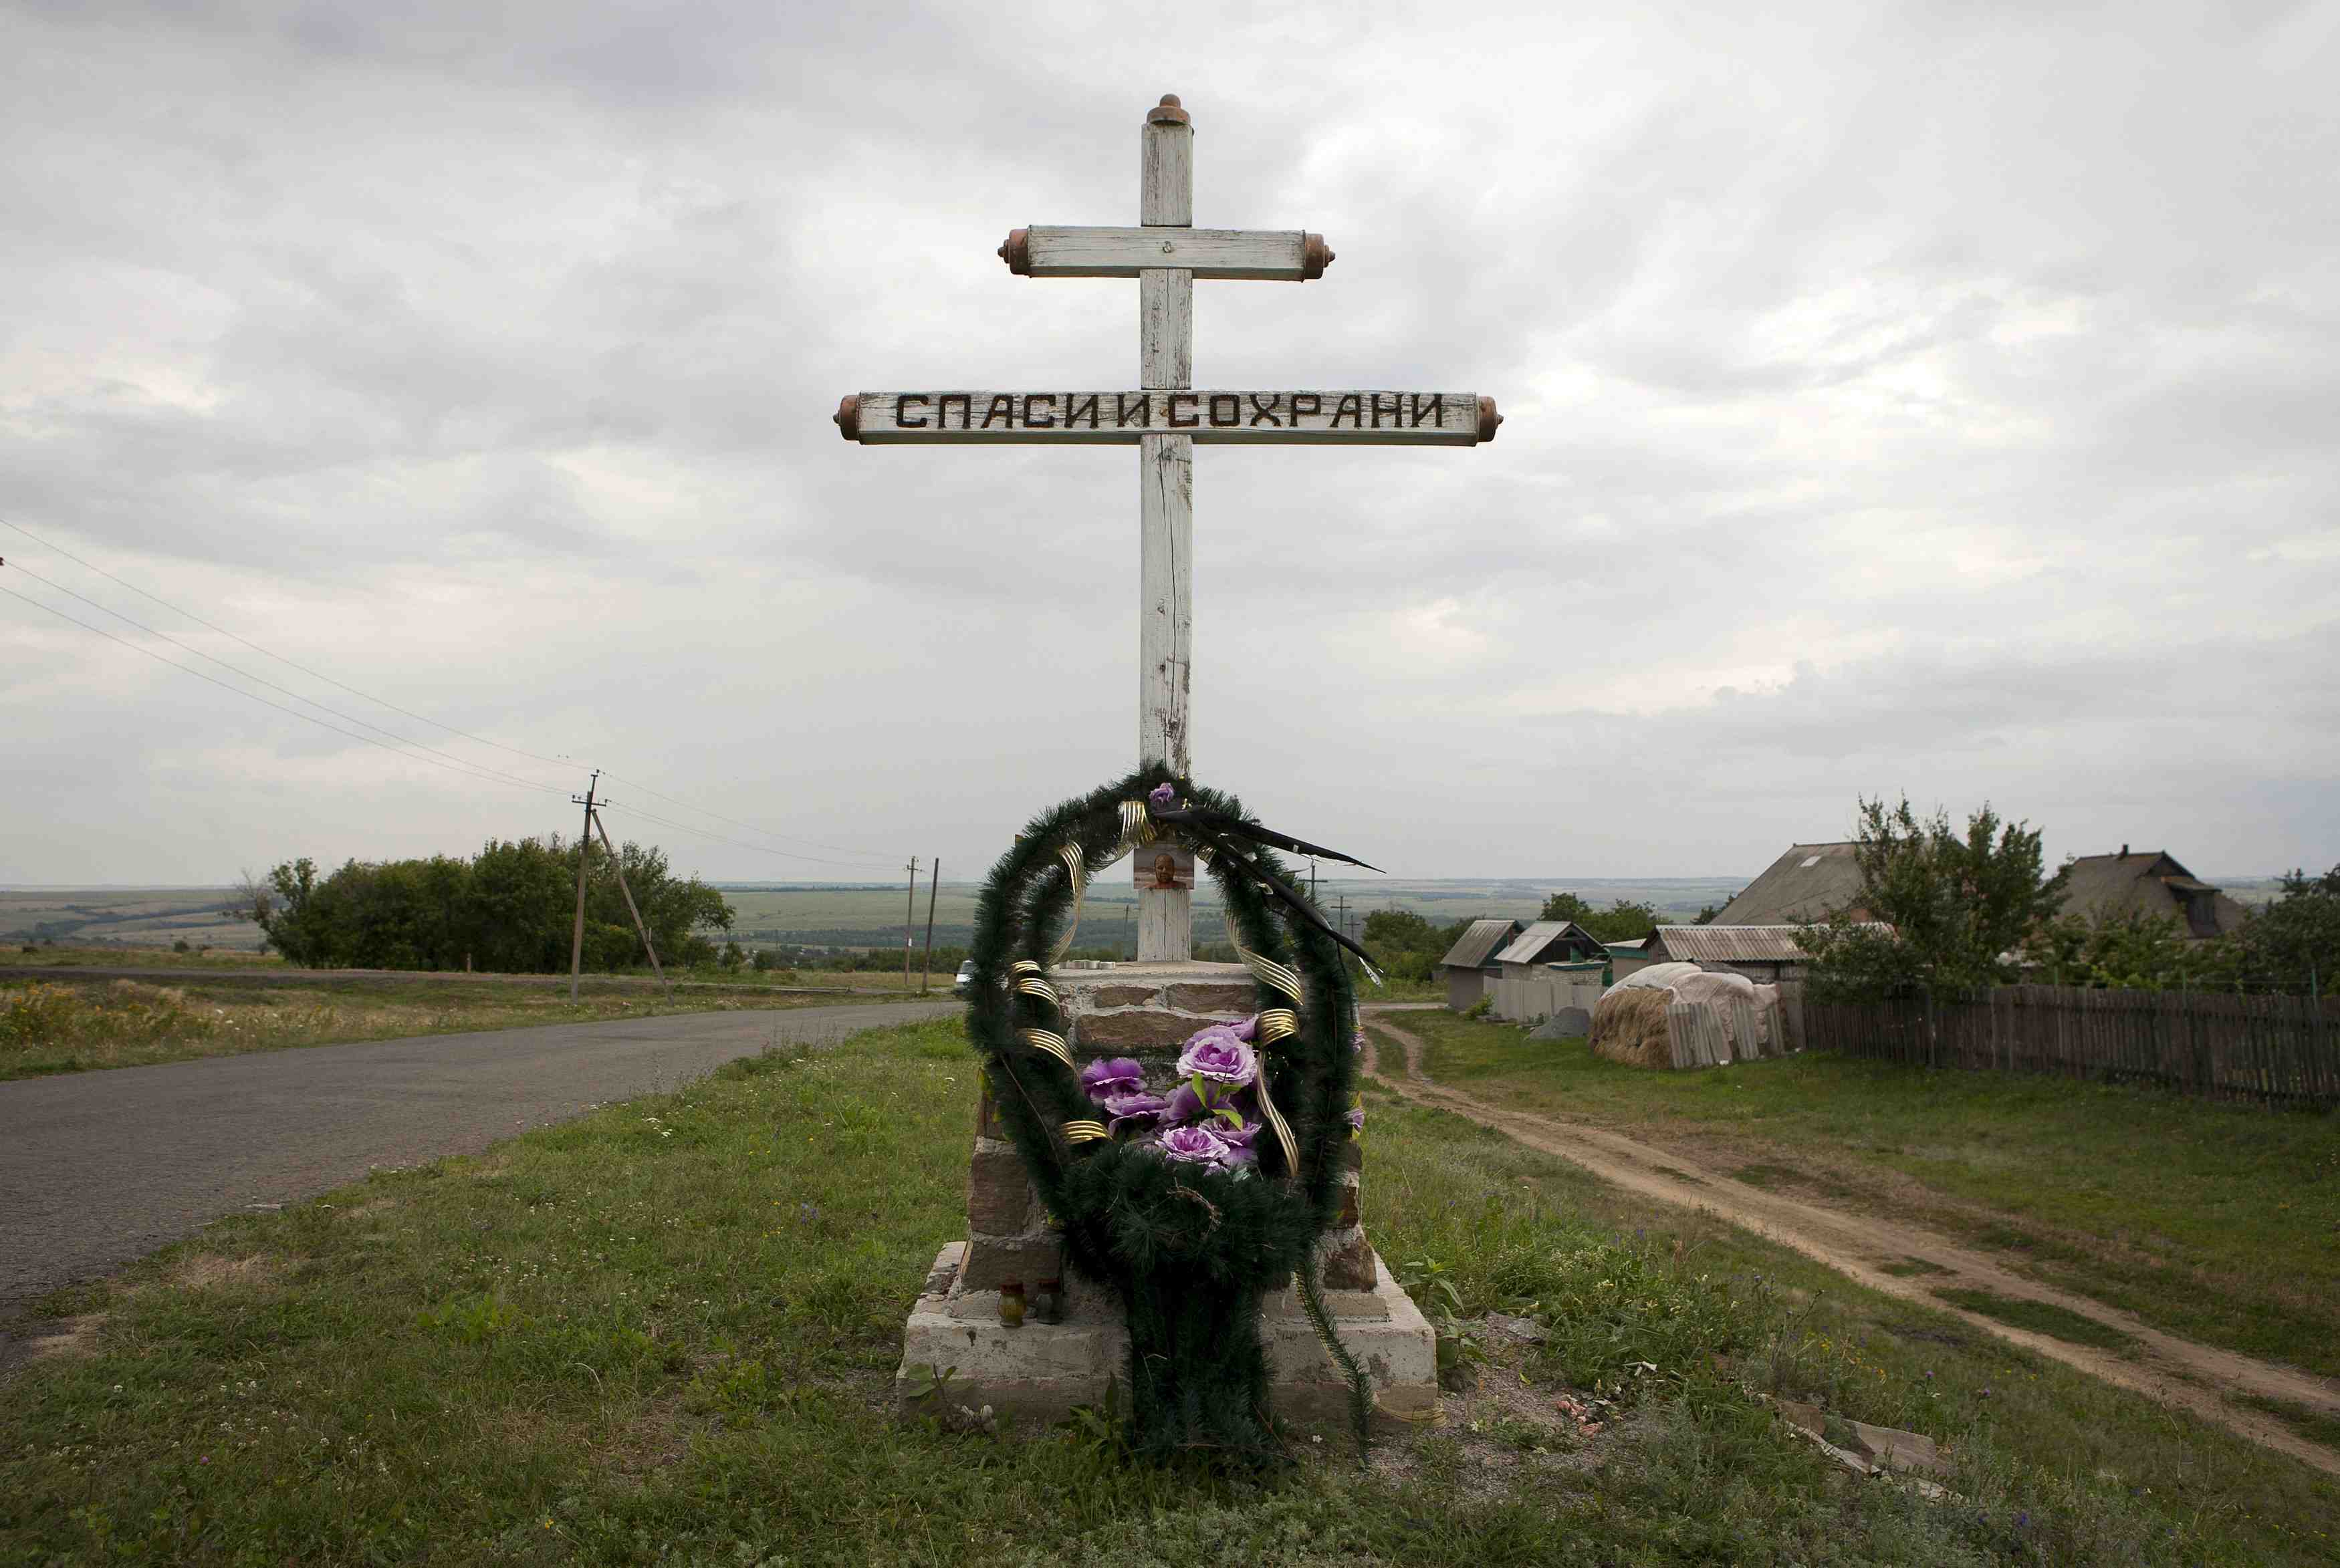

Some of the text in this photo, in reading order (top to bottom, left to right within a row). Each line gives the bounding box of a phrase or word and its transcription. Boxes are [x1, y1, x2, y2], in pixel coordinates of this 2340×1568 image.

[896, 394, 1443, 428] СПАСИ И СОХРАНИ
